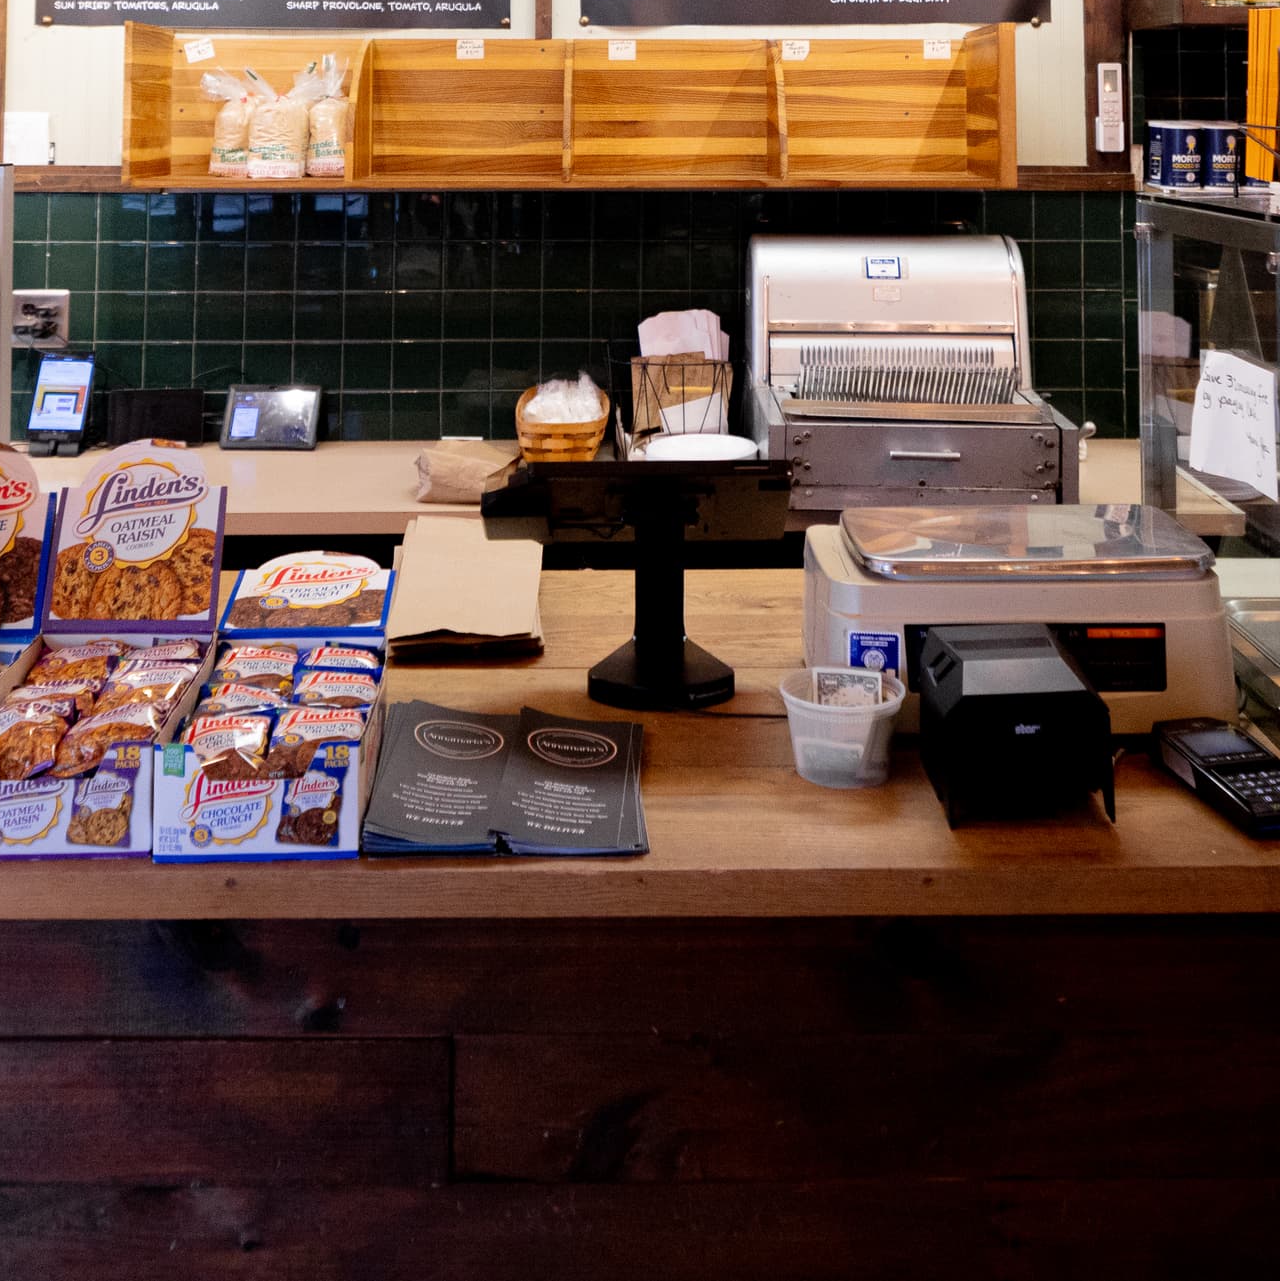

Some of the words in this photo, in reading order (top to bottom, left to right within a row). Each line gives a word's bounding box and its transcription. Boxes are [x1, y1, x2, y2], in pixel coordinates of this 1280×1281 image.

[54, 1, 74, 10] SUN
[78, 1, 110, 10] DRIED
[114, 2, 169, 12] TOMATOES,
[172, 2, 219, 10] ARUGULA
[76, 473, 204, 534] Linden's
[111, 514, 176, 533] OATMEAL
[116, 527, 166, 545] RAISIN
[94, 551, 104, 561] 3
[254, 566, 373, 591] Linden's
[282, 583, 351, 594] CHOCOLATE
[290, 590, 340, 598] CRUNCH
[116, 745, 141, 761] 18
[325, 745, 349, 760] 18
[115, 761, 140, 769] PACKS
[324, 760, 349, 768] PACKS
[201, 800, 262, 819] CHOCOLATE
[3, 814, 40, 828] RAISIN
[210, 813, 253, 828] CRUNCH
